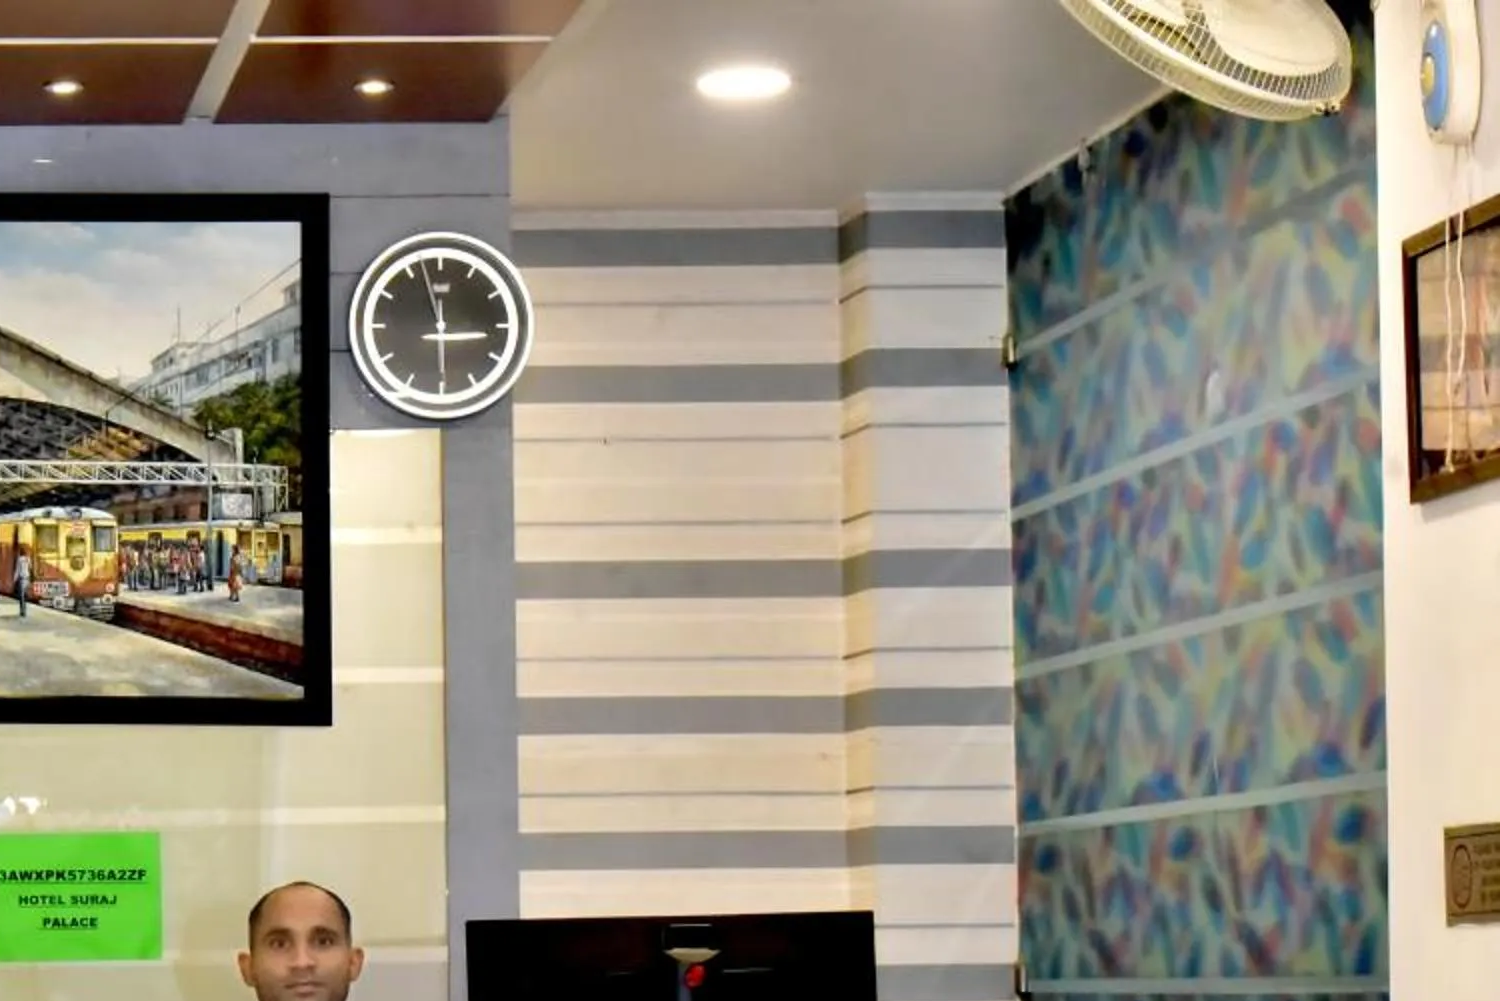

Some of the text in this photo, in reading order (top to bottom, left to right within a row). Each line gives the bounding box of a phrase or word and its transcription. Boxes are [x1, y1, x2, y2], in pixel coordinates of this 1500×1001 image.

[18, 895, 117, 906] HOTEL SURAJ
[43, 917, 98, 928] PALACE
